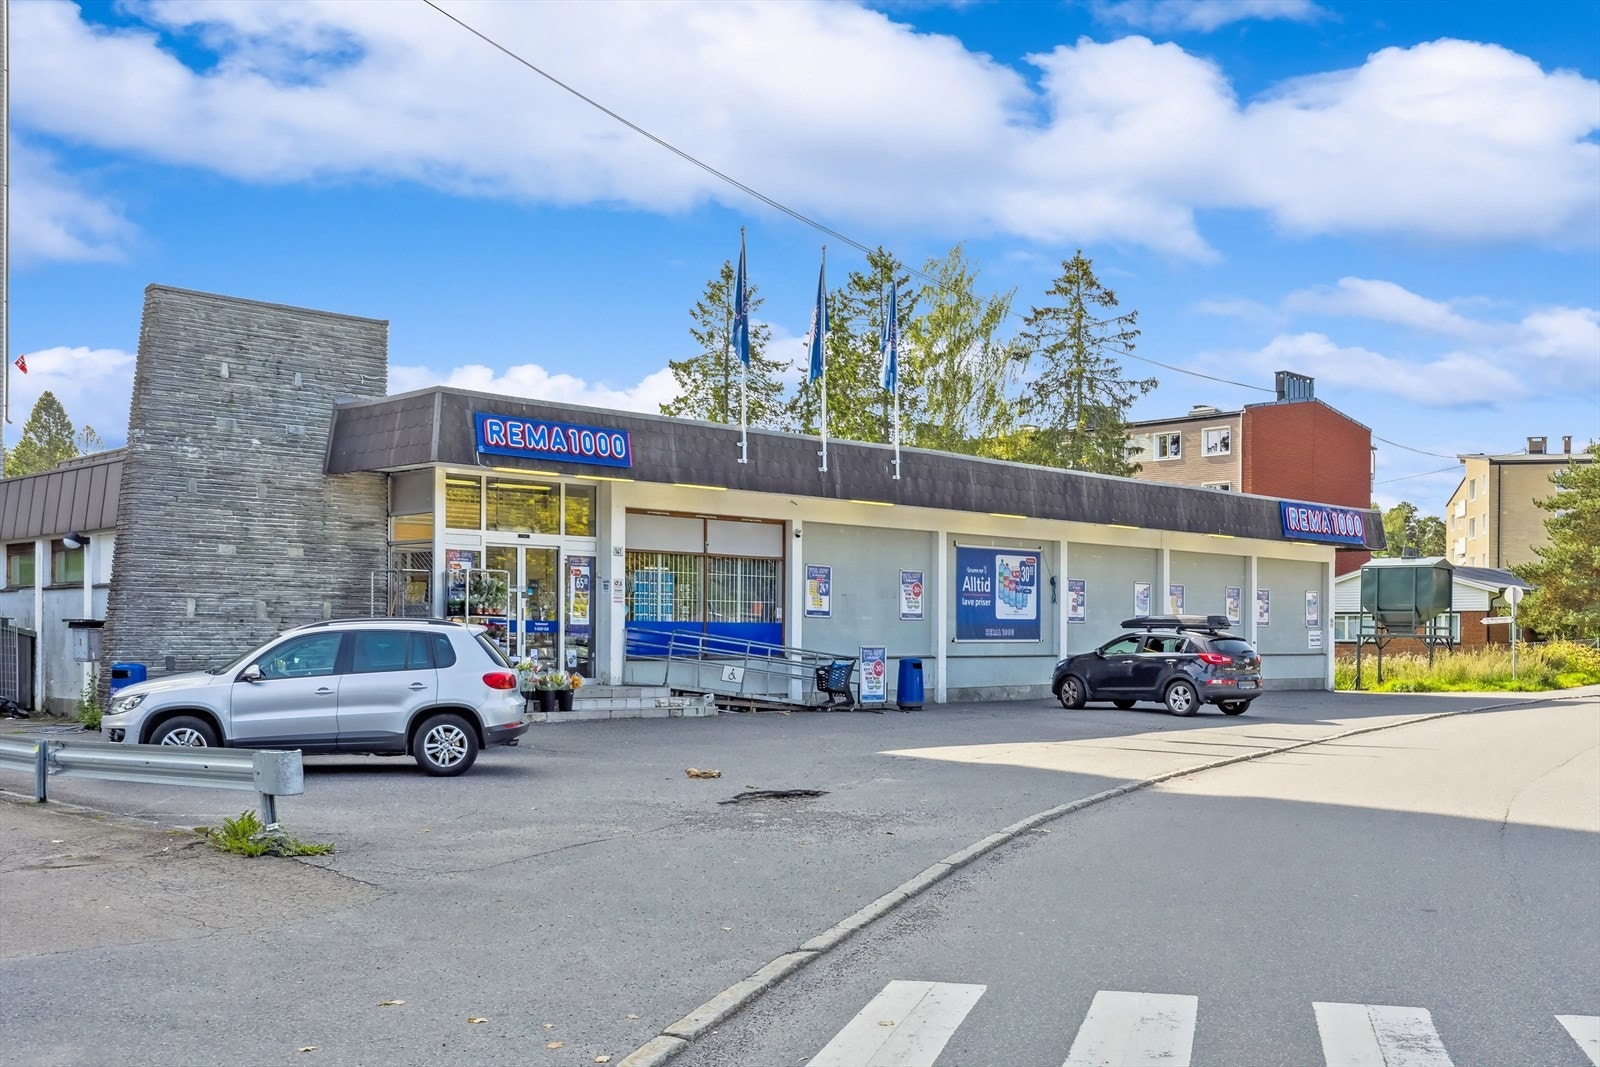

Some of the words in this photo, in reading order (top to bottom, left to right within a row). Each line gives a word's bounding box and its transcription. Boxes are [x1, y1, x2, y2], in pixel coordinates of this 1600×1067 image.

[1286, 507, 1331, 534] REMA
[1330, 512, 1363, 537] 1000
[1020, 566, 1030, 582] 30
[576, 577, 584, 589] 65
[962, 576, 991, 592] Alltid
[961, 597, 974, 605] lave
[975, 597, 991, 607] priser
